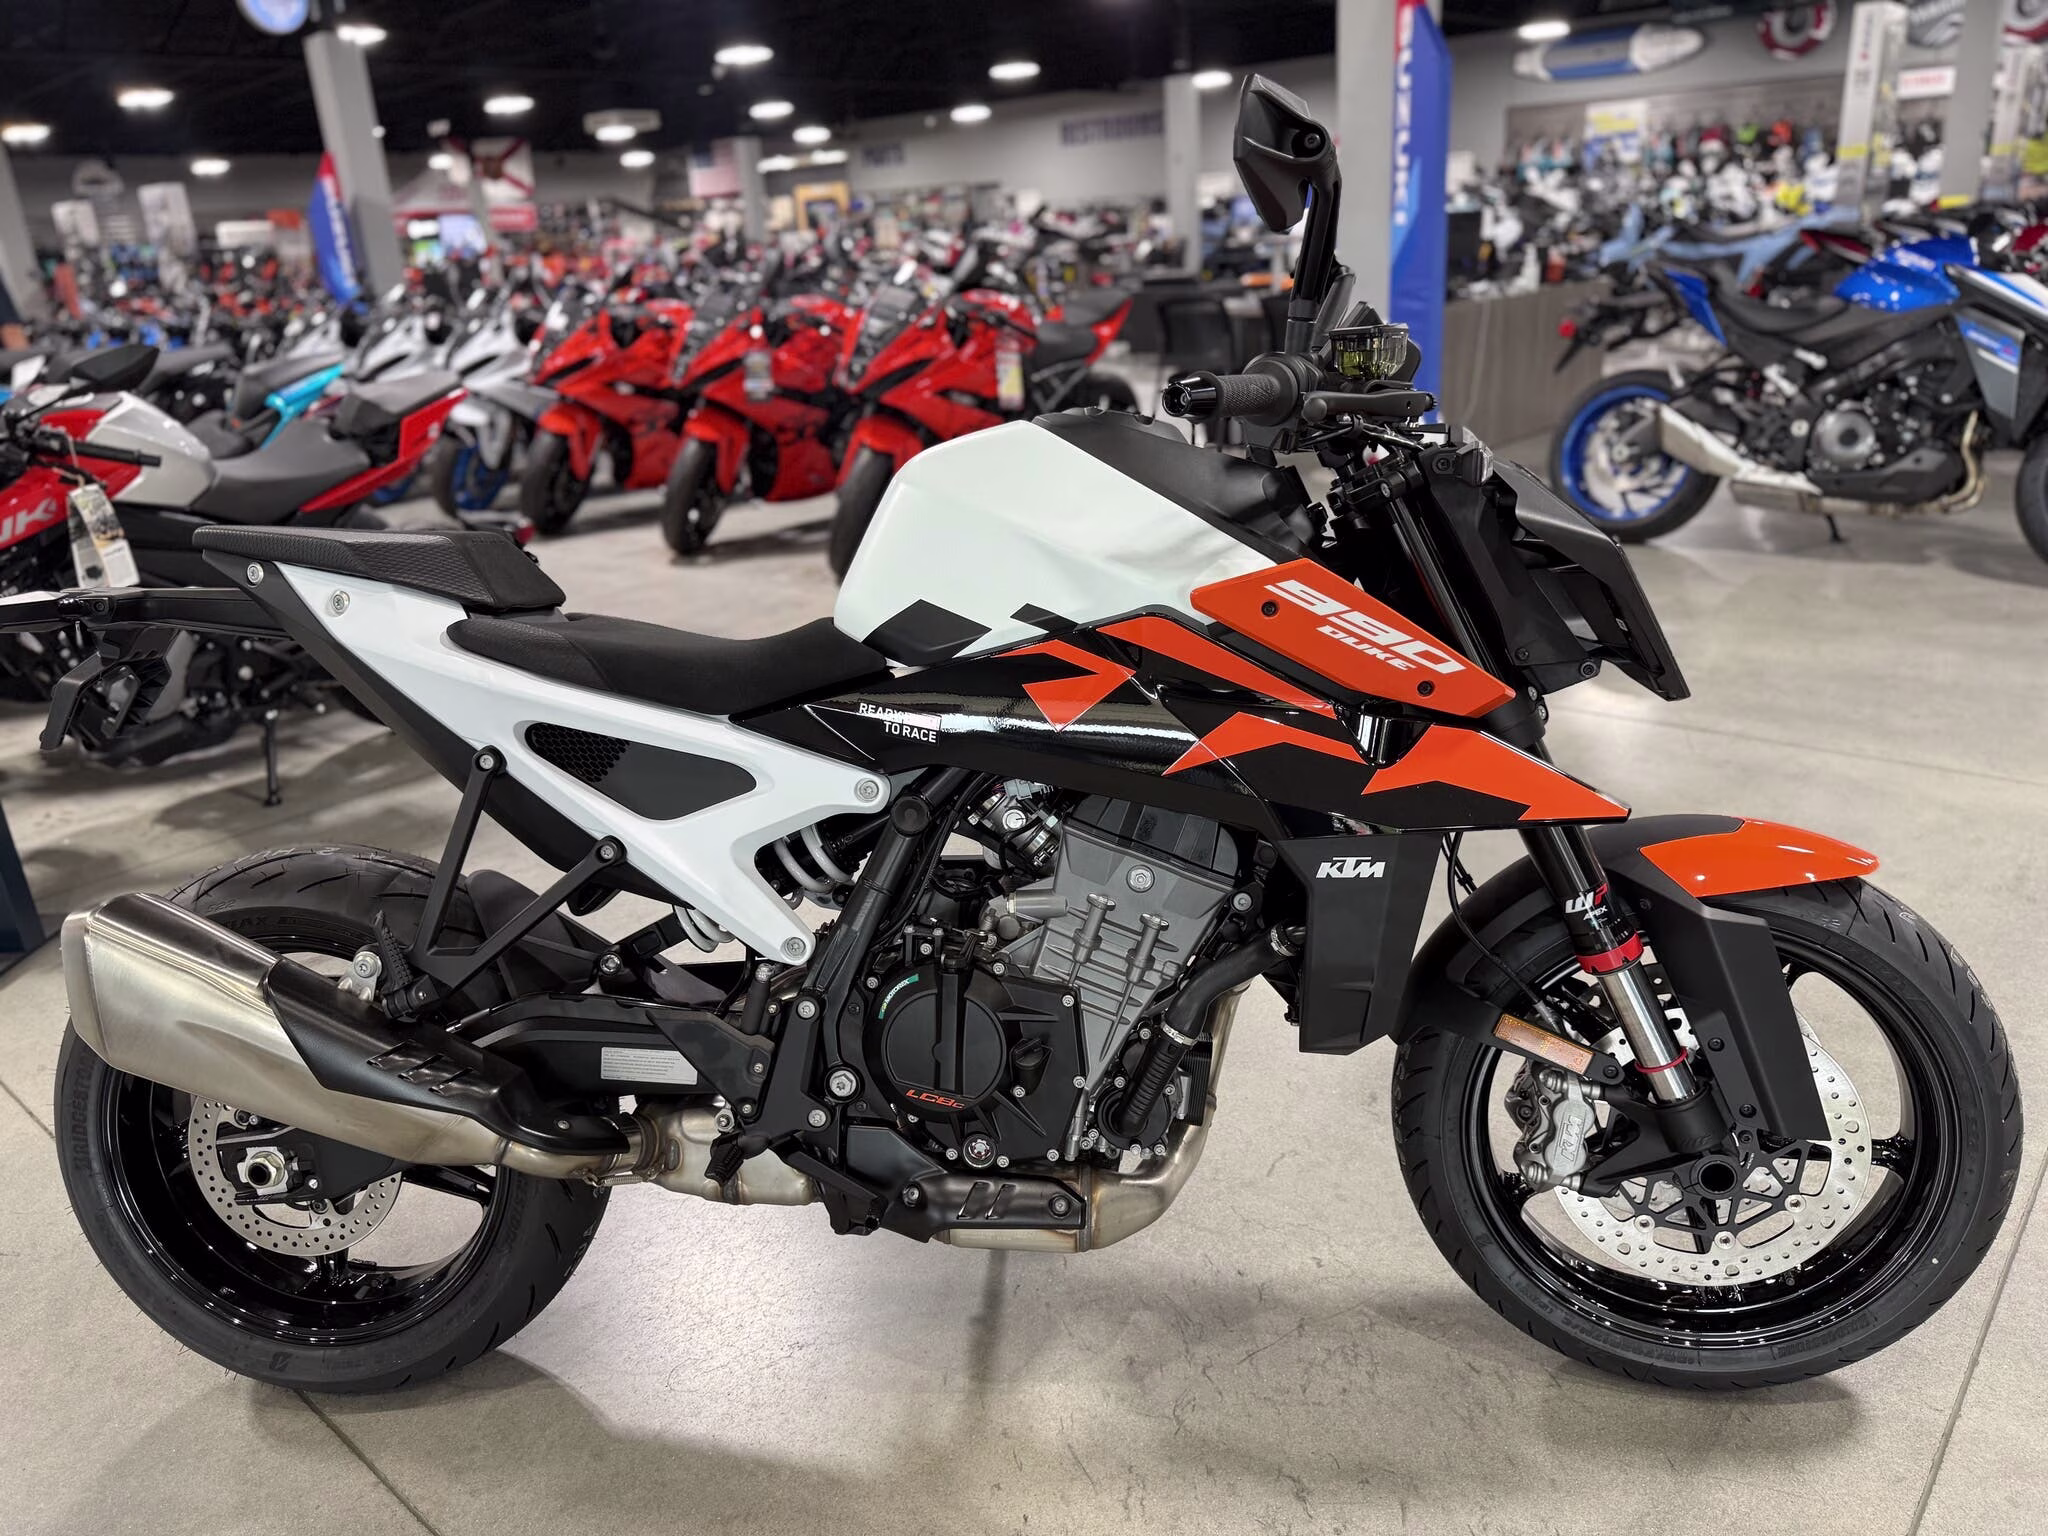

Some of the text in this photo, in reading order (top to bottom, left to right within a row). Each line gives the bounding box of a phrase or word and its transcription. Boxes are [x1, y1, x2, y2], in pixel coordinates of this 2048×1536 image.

[1264, 579, 1467, 675] 990
[1316, 624, 1417, 671] DUKE
[883, 721, 937, 743] TO RACE
[1315, 856, 1386, 878] KTM
[884, 979, 910, 1004] MOTOREX
[1559, 1114, 1583, 1162] KTM
